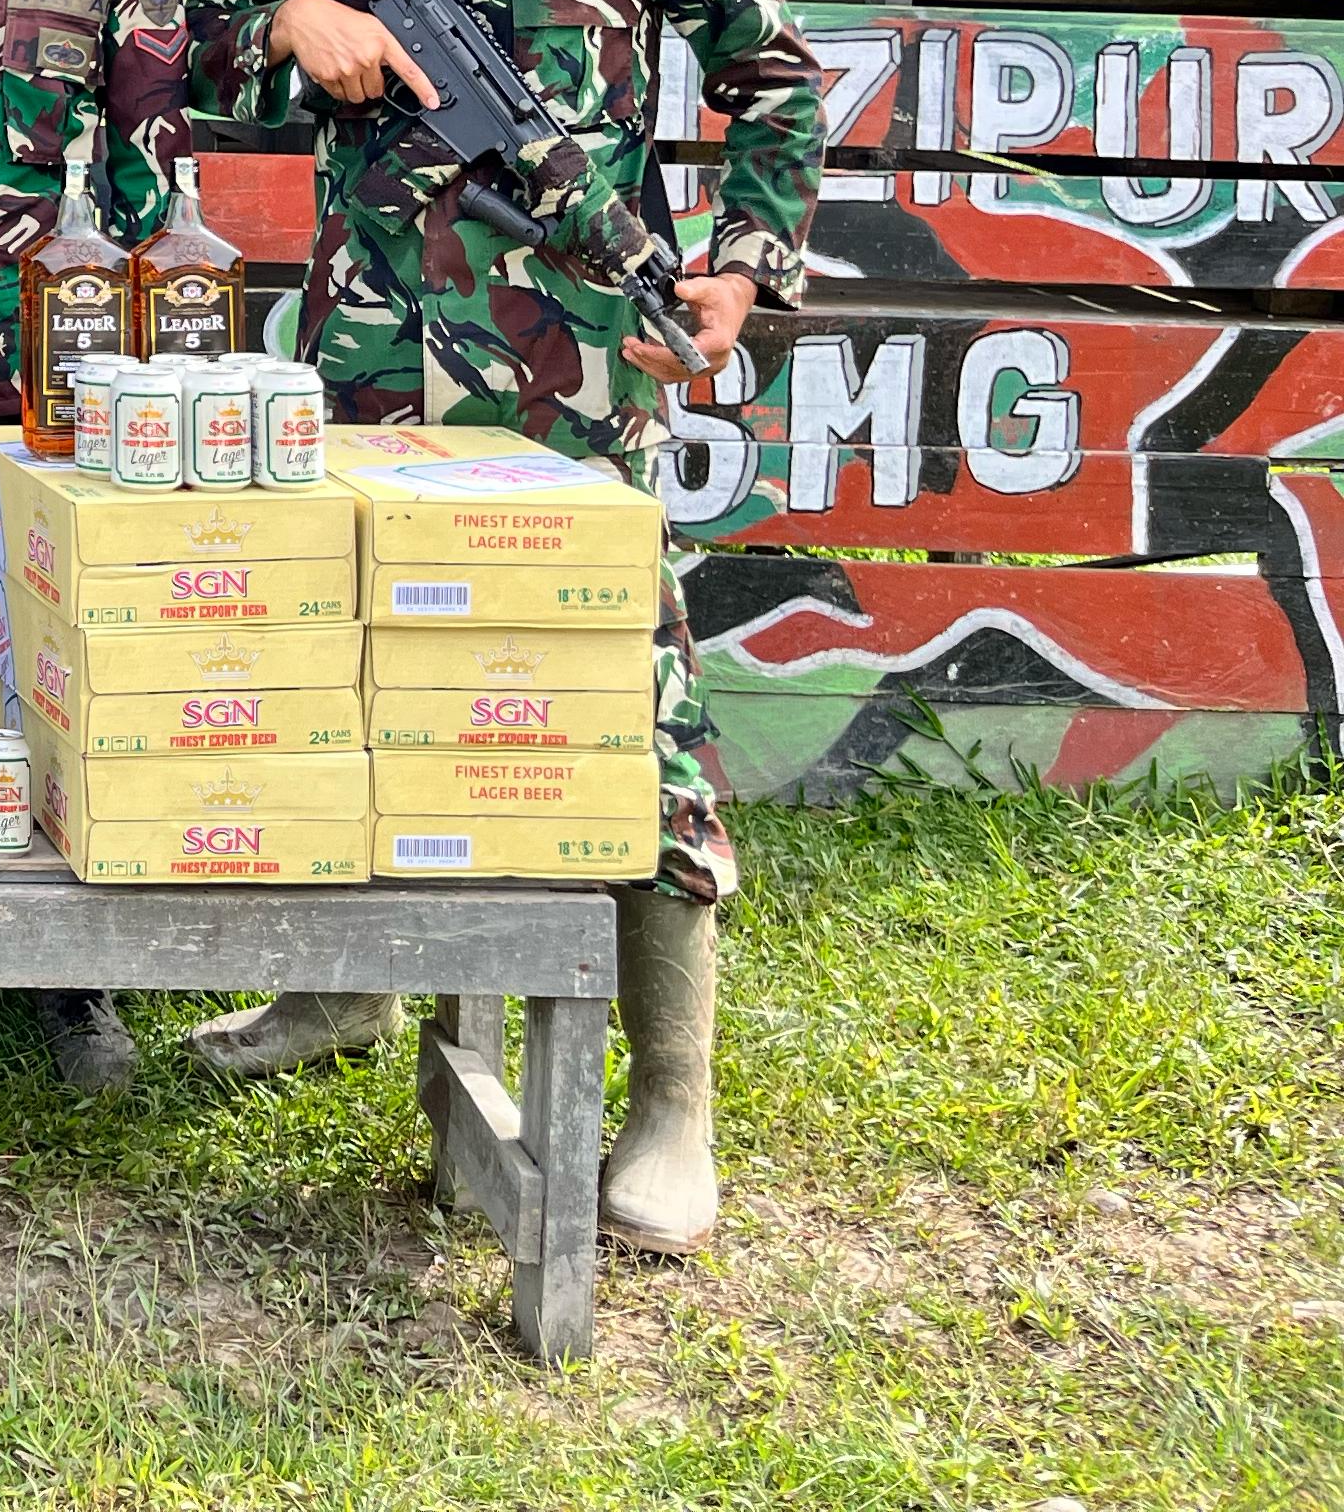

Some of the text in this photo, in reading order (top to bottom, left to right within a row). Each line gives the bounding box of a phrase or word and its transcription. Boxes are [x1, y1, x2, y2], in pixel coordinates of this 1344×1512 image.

[52, 314, 117, 332] LEADER
[159, 314, 226, 332] LEADER
[76, 332, 92, 349] 5
[184, 332, 201, 349] 5
[127, 420, 171, 438] SGN
[208, 419, 248, 437] SGN
[281, 419, 320, 437] SGN
[454, 514, 575, 530] FINEST EXPORT
[468, 535, 562, 551] LAGER BEER
[170, 568, 253, 600] SGN
[298, 601, 320, 617] 24
[181, 697, 264, 729] SGN
[470, 697, 554, 728] SGN
[308, 730, 330, 745] 24
[599, 734, 622, 749] 24
[454, 765, 575, 781] FINEST EXPORT
[469, 786, 563, 801] LAGER BEER
[182, 826, 265, 856] SGN
[311, 860, 332, 875] 24
